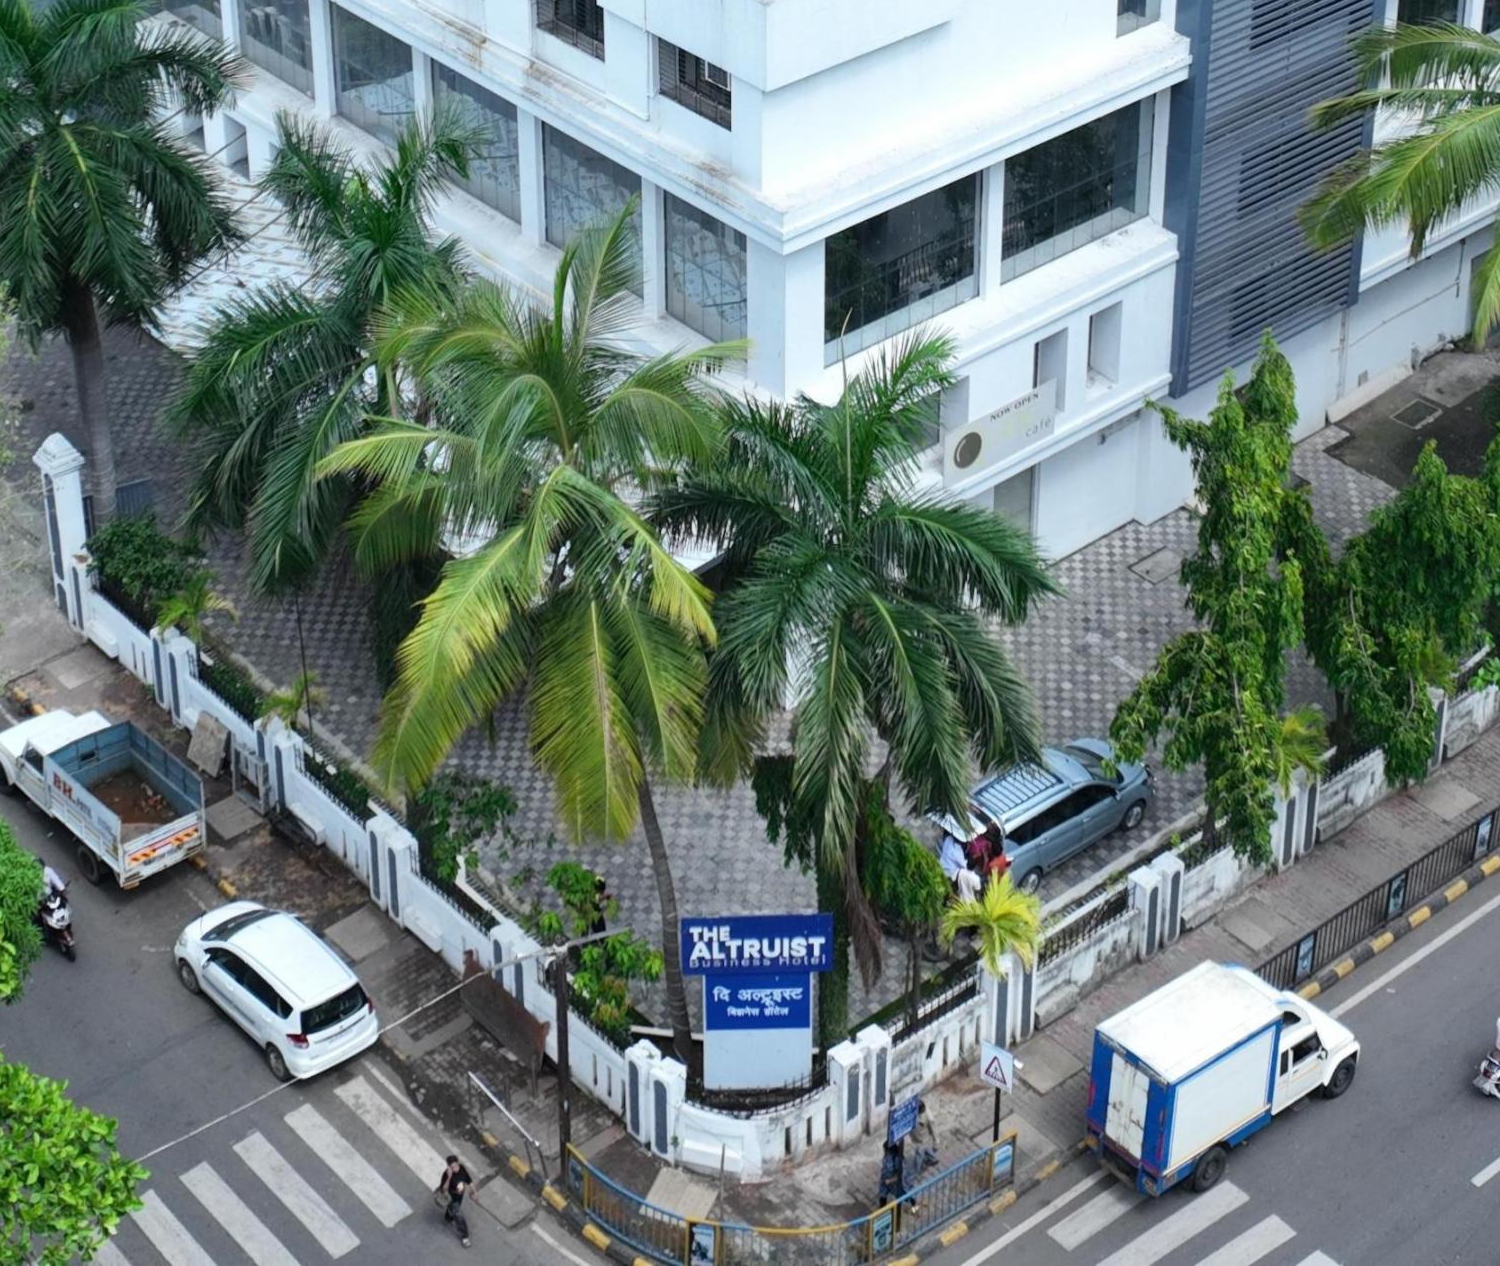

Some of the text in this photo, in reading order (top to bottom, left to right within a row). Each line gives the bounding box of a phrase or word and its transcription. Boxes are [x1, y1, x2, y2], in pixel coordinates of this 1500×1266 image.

[990, 393, 1039, 422] NOW OPEN
[689, 926, 730, 943] THE
[689, 937, 826, 960] ALTRUIST
[689, 953, 826, 969] Business Hotel
[712, 986, 731, 1002] दि
